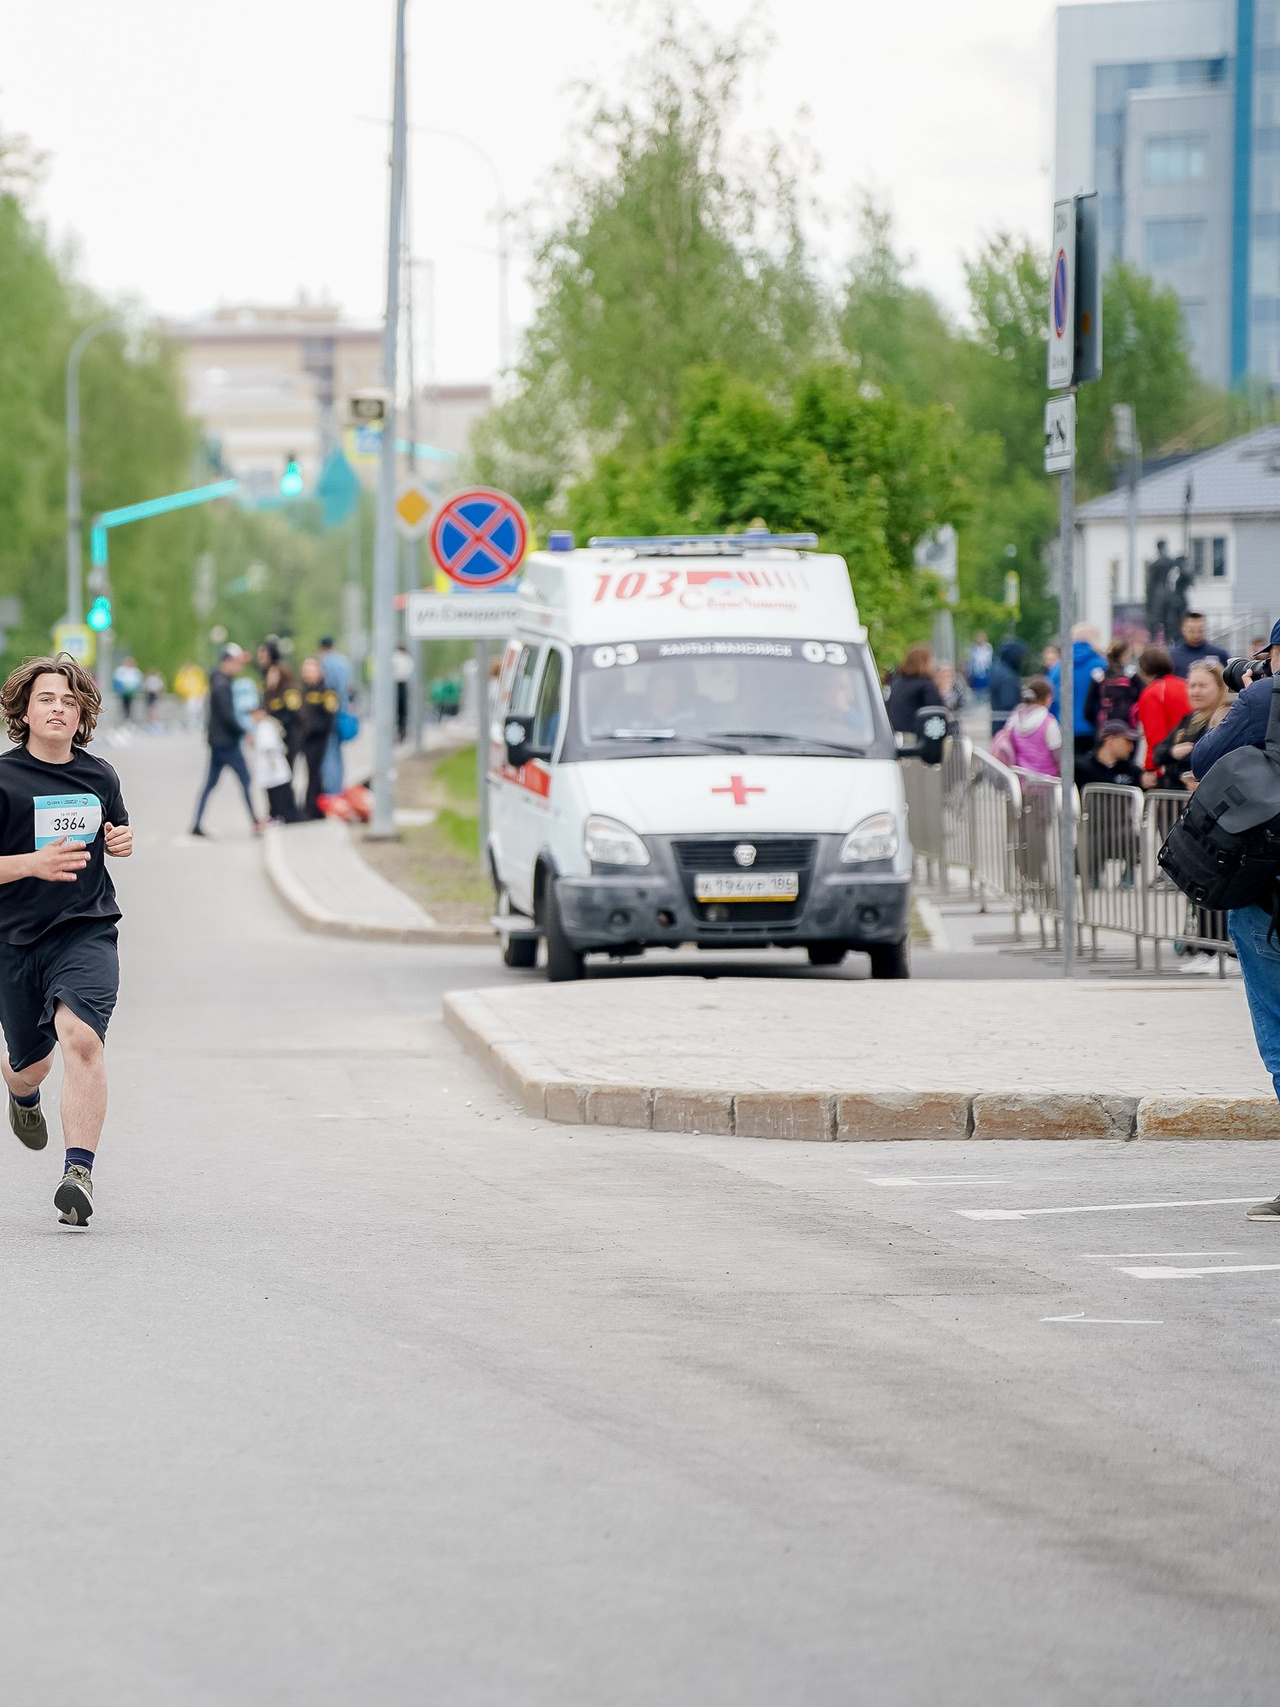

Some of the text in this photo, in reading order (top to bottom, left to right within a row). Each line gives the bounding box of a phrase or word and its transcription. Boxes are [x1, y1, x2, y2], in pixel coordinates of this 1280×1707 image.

[593, 572, 680, 602] 103
[593, 643, 639, 668] 03
[801, 641, 848, 665] 03
[53, 817, 86, 831] 3364
